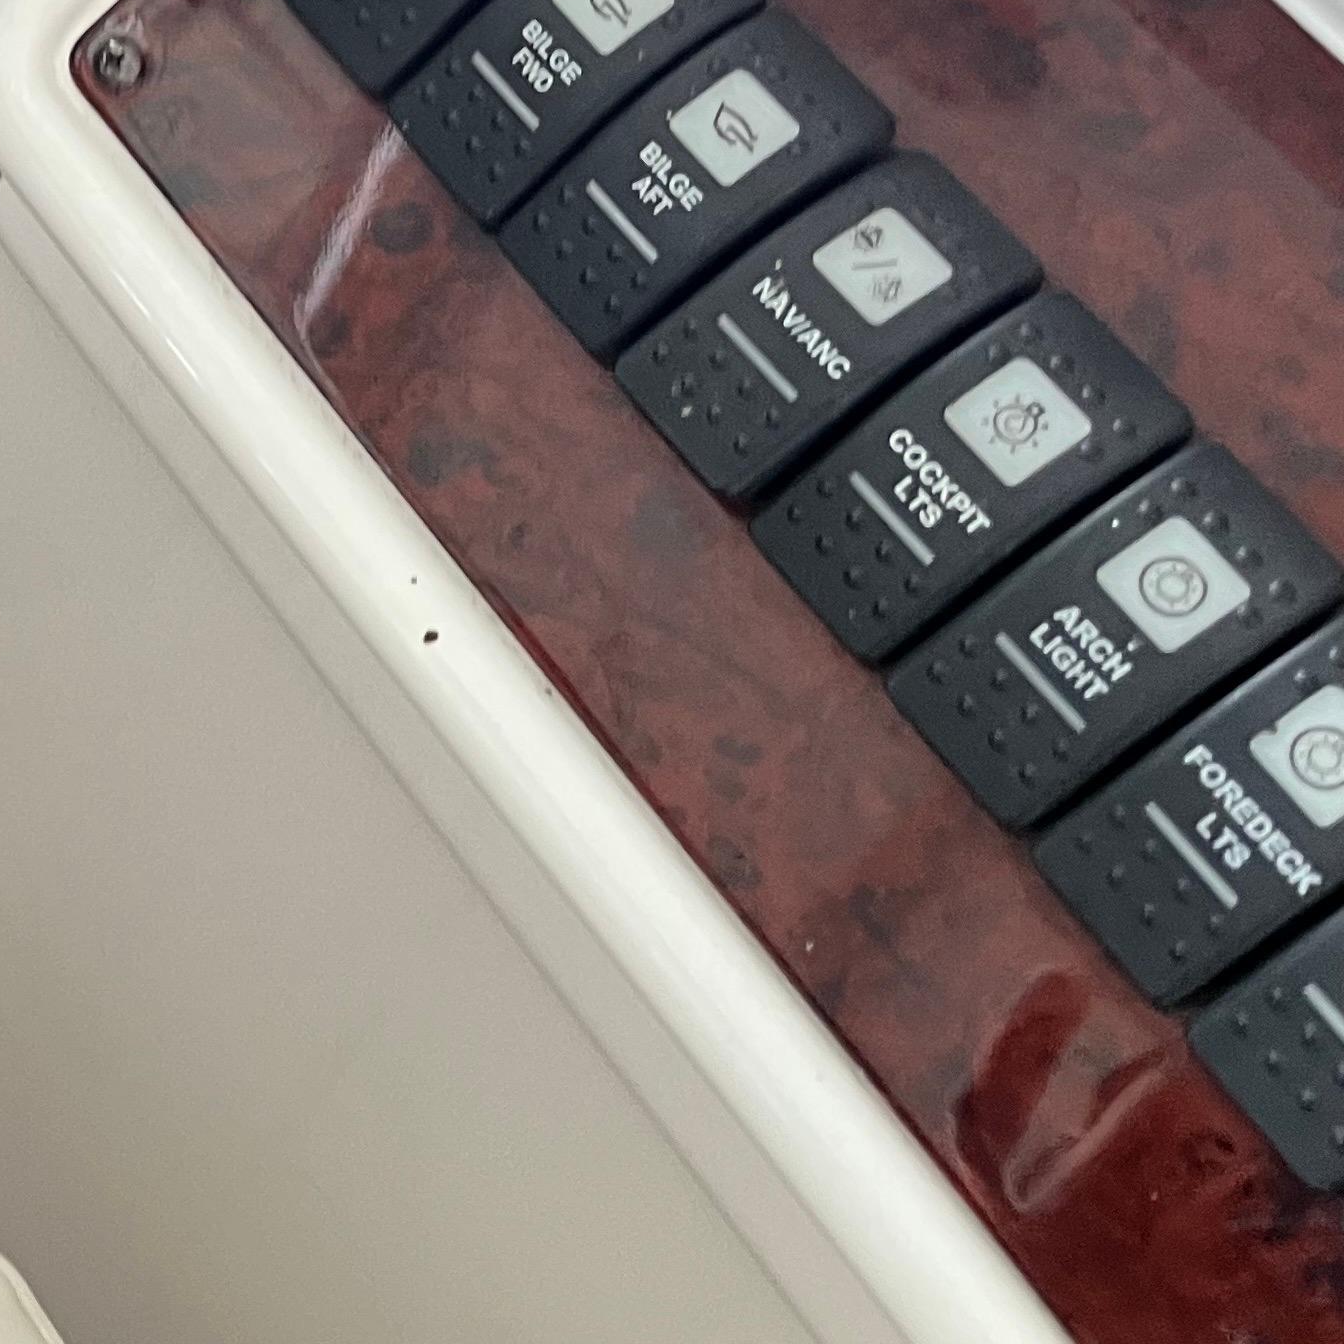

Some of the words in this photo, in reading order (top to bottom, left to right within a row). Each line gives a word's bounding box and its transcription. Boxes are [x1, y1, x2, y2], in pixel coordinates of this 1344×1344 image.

[522, 19, 582, 86] BILGE
[631, 177, 673, 216] AFT
[639, 141, 703, 212] BILGE
[752, 277, 851, 380] NAV/ANC
[889, 428, 992, 534] COCKPIT
[894, 476, 942, 529] LTS
[1029, 623, 1109, 700] LIGHT
[1053, 606, 1133, 681] ARCH
[1183, 745, 1323, 897] FOREDECK
[1197, 813, 1252, 870] LTS
